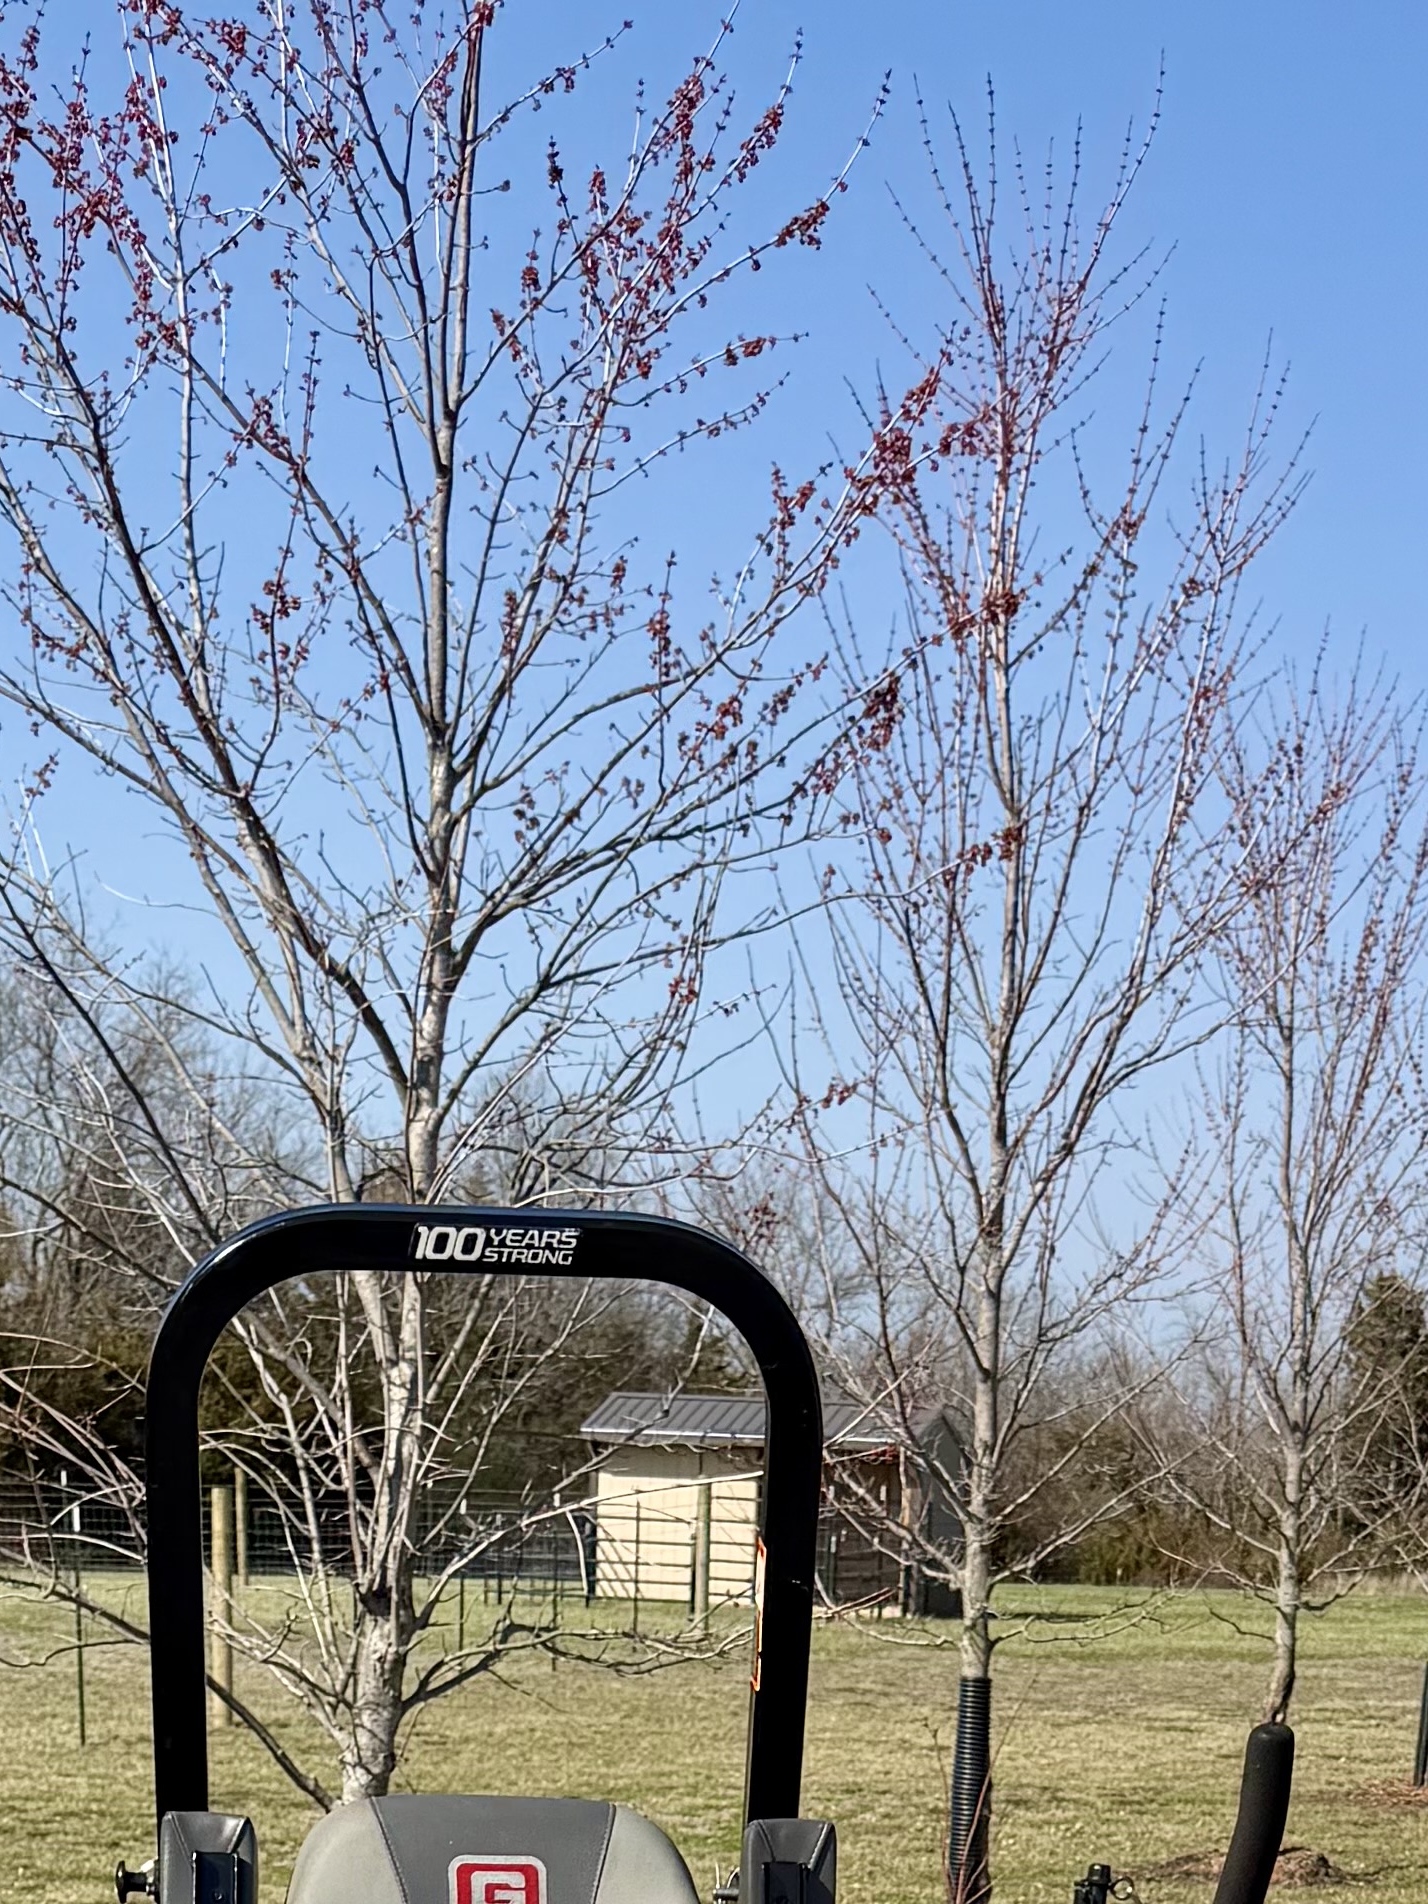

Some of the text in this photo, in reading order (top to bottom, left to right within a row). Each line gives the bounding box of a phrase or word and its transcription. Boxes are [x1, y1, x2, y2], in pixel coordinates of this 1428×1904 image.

[414, 1226, 580, 1261] 100 YEARS
[482, 1247, 574, 1265] STRONG
